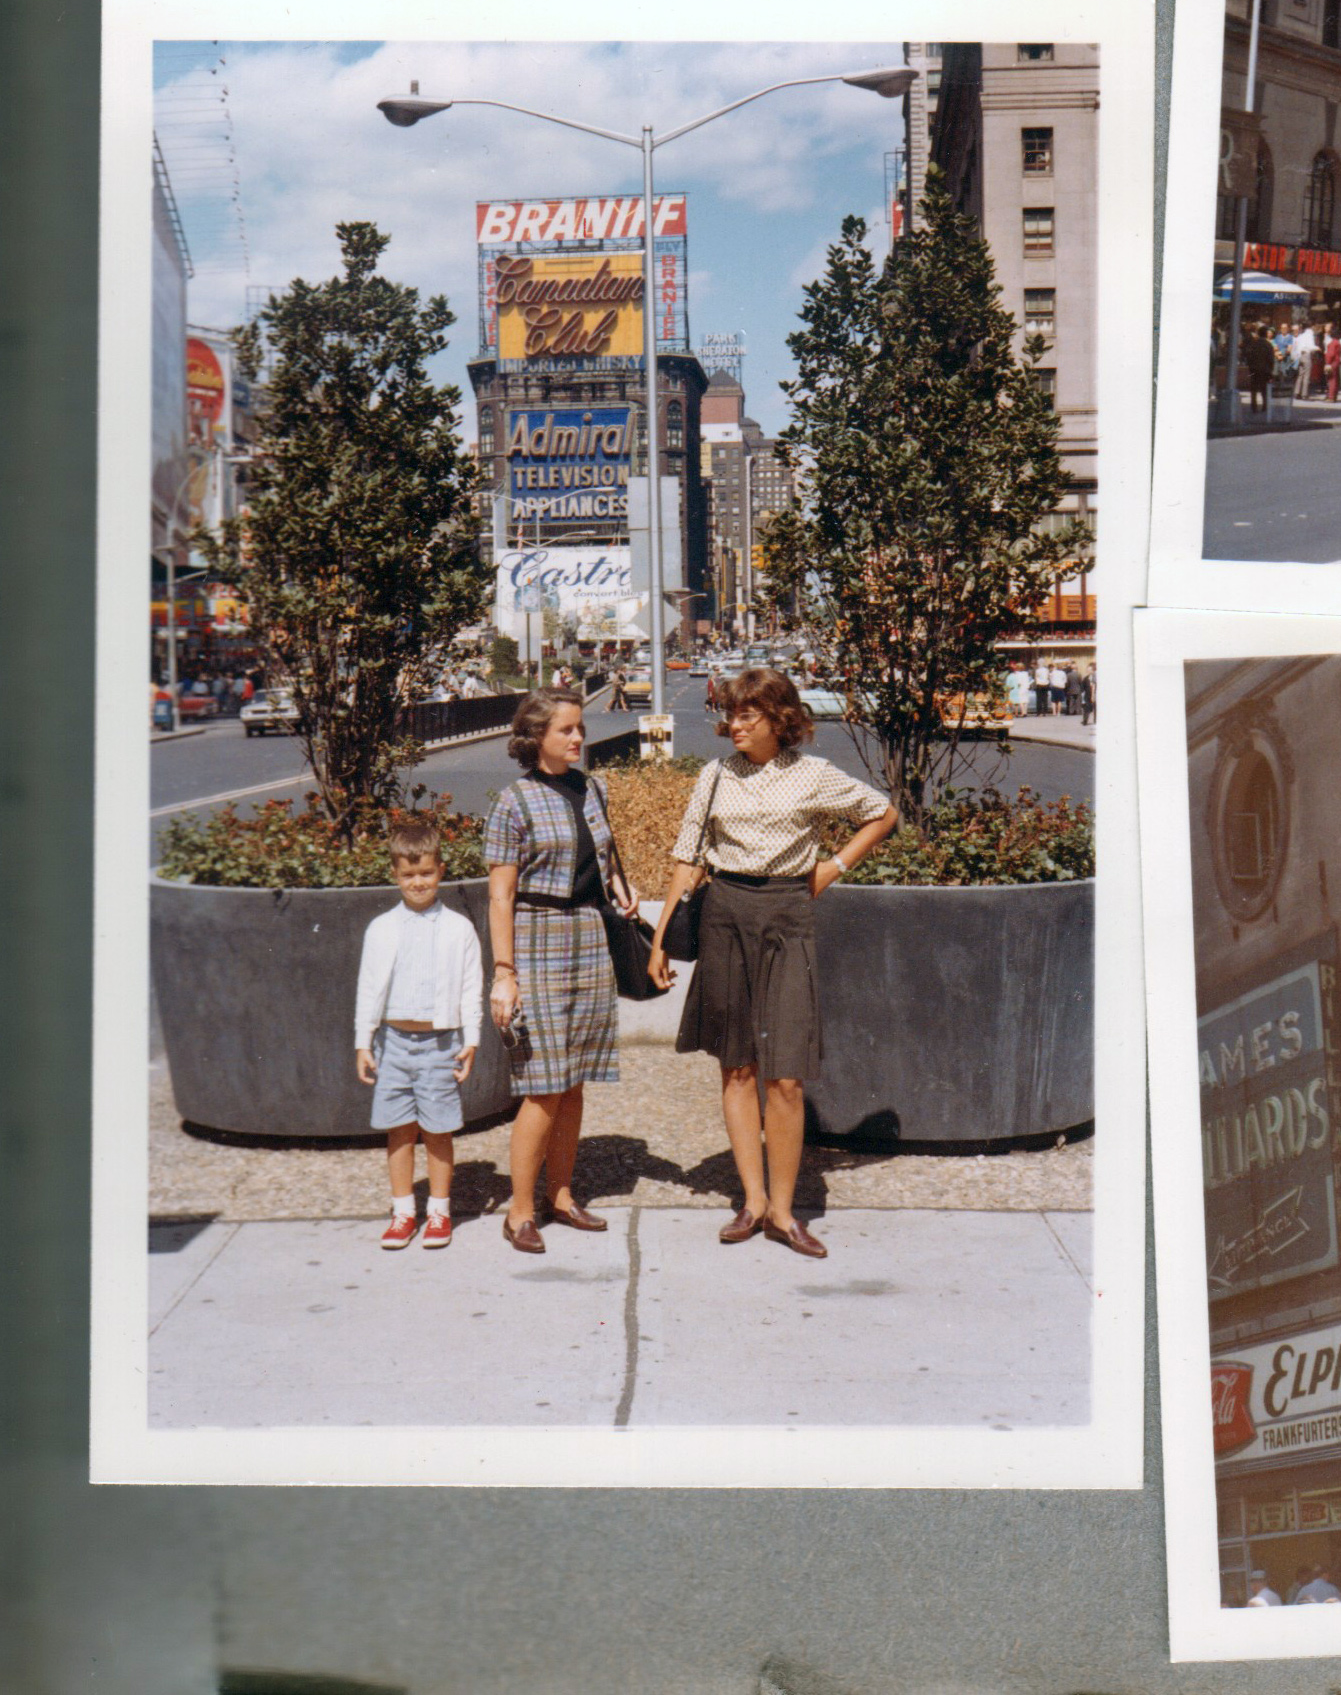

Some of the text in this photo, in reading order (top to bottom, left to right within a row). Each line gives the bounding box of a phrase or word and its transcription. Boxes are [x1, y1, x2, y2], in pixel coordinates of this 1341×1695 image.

[478, 196, 686, 243] BRANIFF
[1243, 242, 1287, 272] ASTOR
[495, 255, 645, 306] Canadian
[661, 255, 677, 340] BRANIFF
[525, 306, 619, 356] Club
[706, 334, 739, 345] PARK
[510, 412, 638, 457] Admiral
[514, 465, 628, 489] TELEVISION
[513, 495, 628, 520] APPLIANCES
